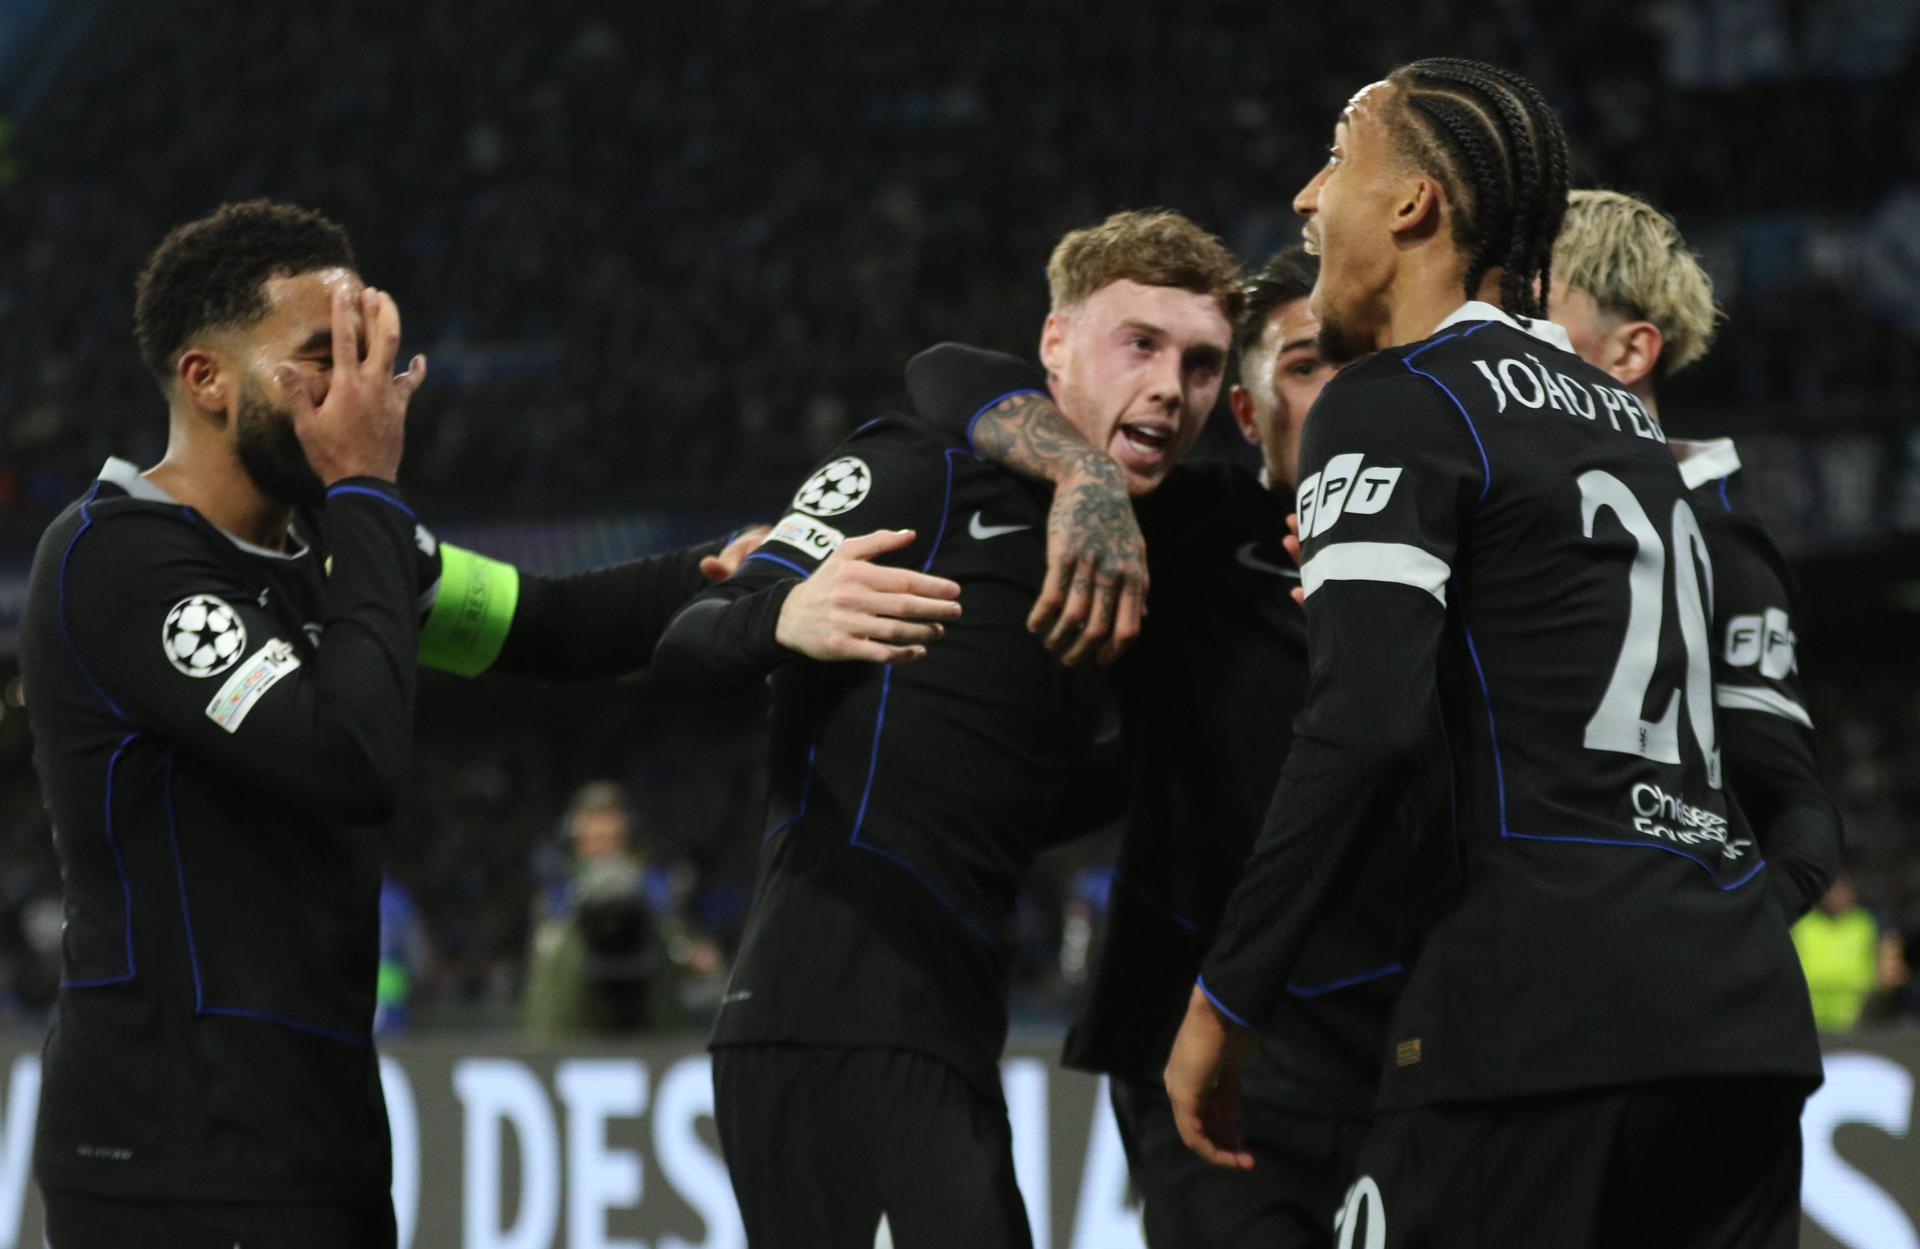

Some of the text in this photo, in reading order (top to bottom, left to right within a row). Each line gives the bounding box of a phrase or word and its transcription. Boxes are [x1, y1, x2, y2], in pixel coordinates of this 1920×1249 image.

[1472, 353, 1596, 420] JOÃO
[1299, 473, 1393, 528] FPT
[1577, 470, 1721, 790] 20
[1334, 1174, 1386, 1249] 0
